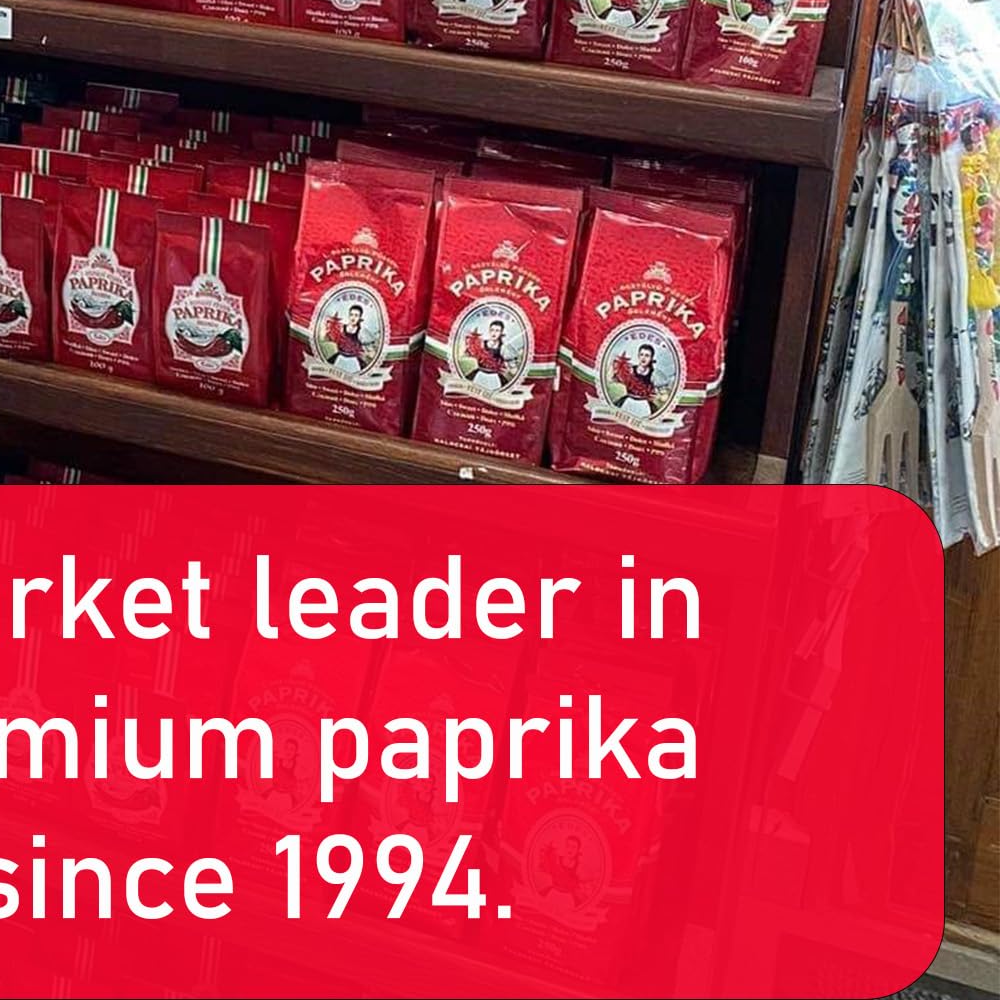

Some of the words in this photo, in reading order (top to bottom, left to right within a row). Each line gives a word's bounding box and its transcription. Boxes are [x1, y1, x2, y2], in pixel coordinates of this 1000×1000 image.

[69, 276, 135, 302] PAPRIKA
[309, 254, 407, 297] PAPRIKA
[448, 268, 552, 313] PAPRIKA
[172, 305, 243, 331] PAPRIKA
[595, 290, 706, 340] PAPRIKA
[467, 422, 493, 439] 250g
